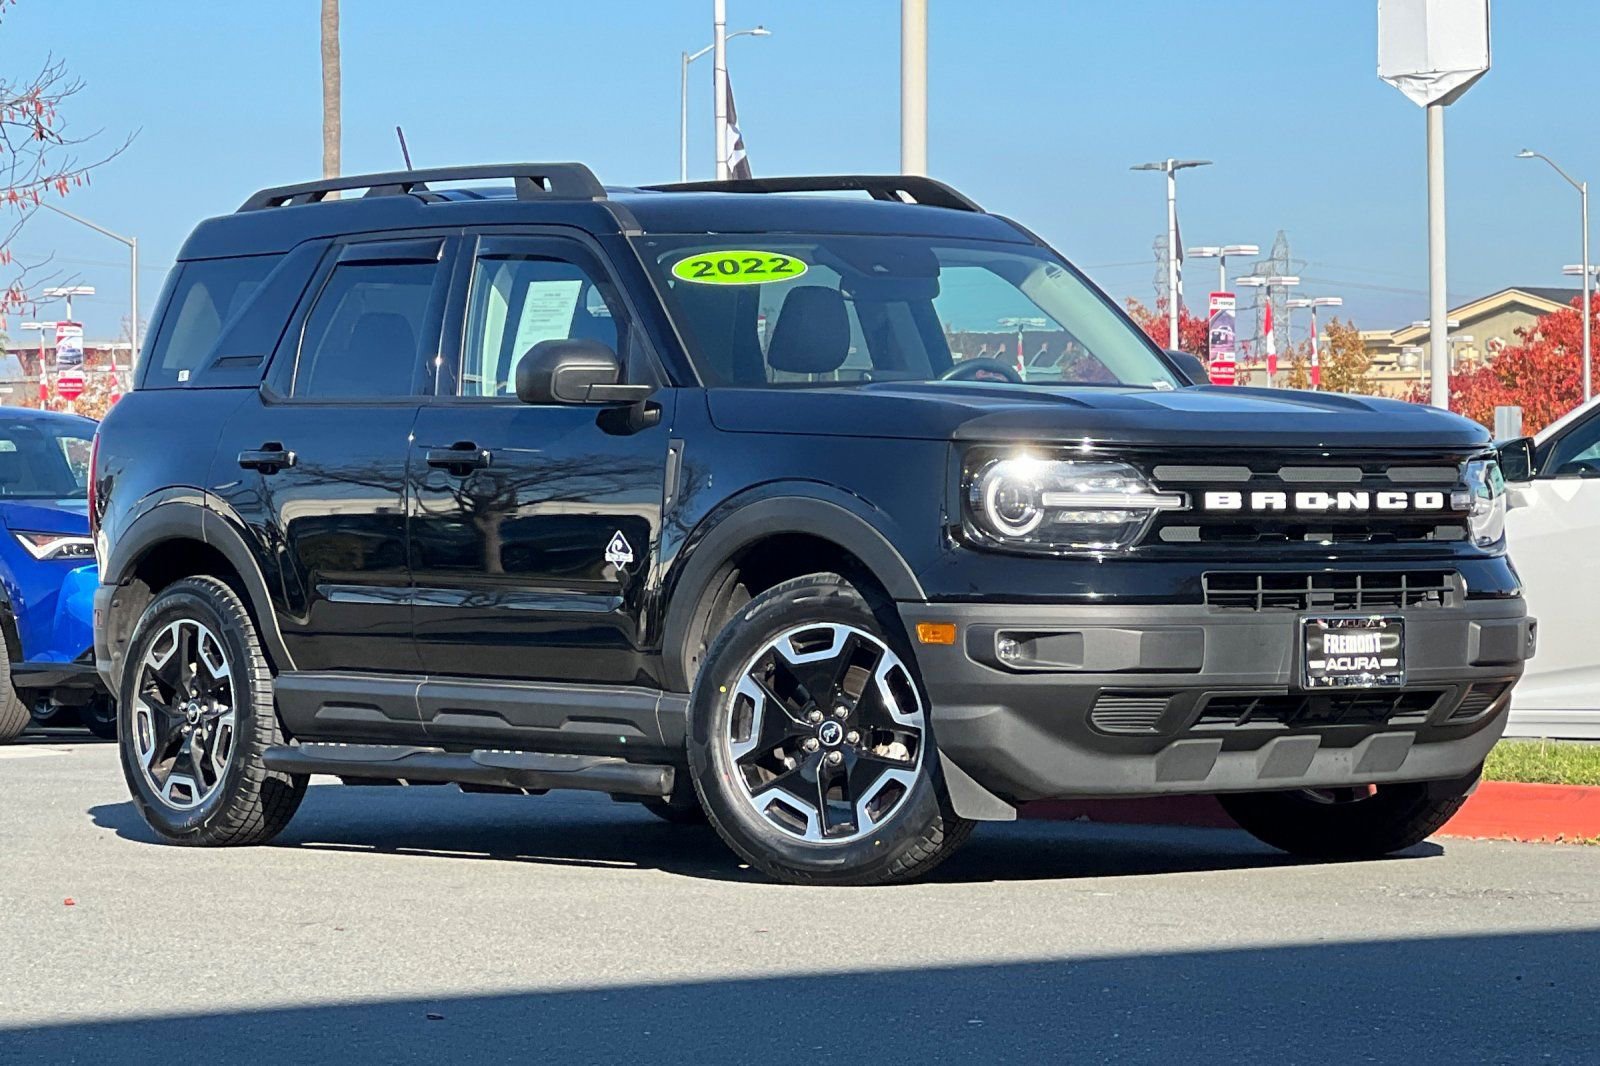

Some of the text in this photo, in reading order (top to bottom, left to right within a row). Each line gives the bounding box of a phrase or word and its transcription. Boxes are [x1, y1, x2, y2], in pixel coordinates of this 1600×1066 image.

[691, 257, 794, 278] 2022
[1204, 491, 1444, 510] BRONCO
[1323, 632, 1381, 654] FREMONT
[1325, 656, 1381, 671] ACURA
